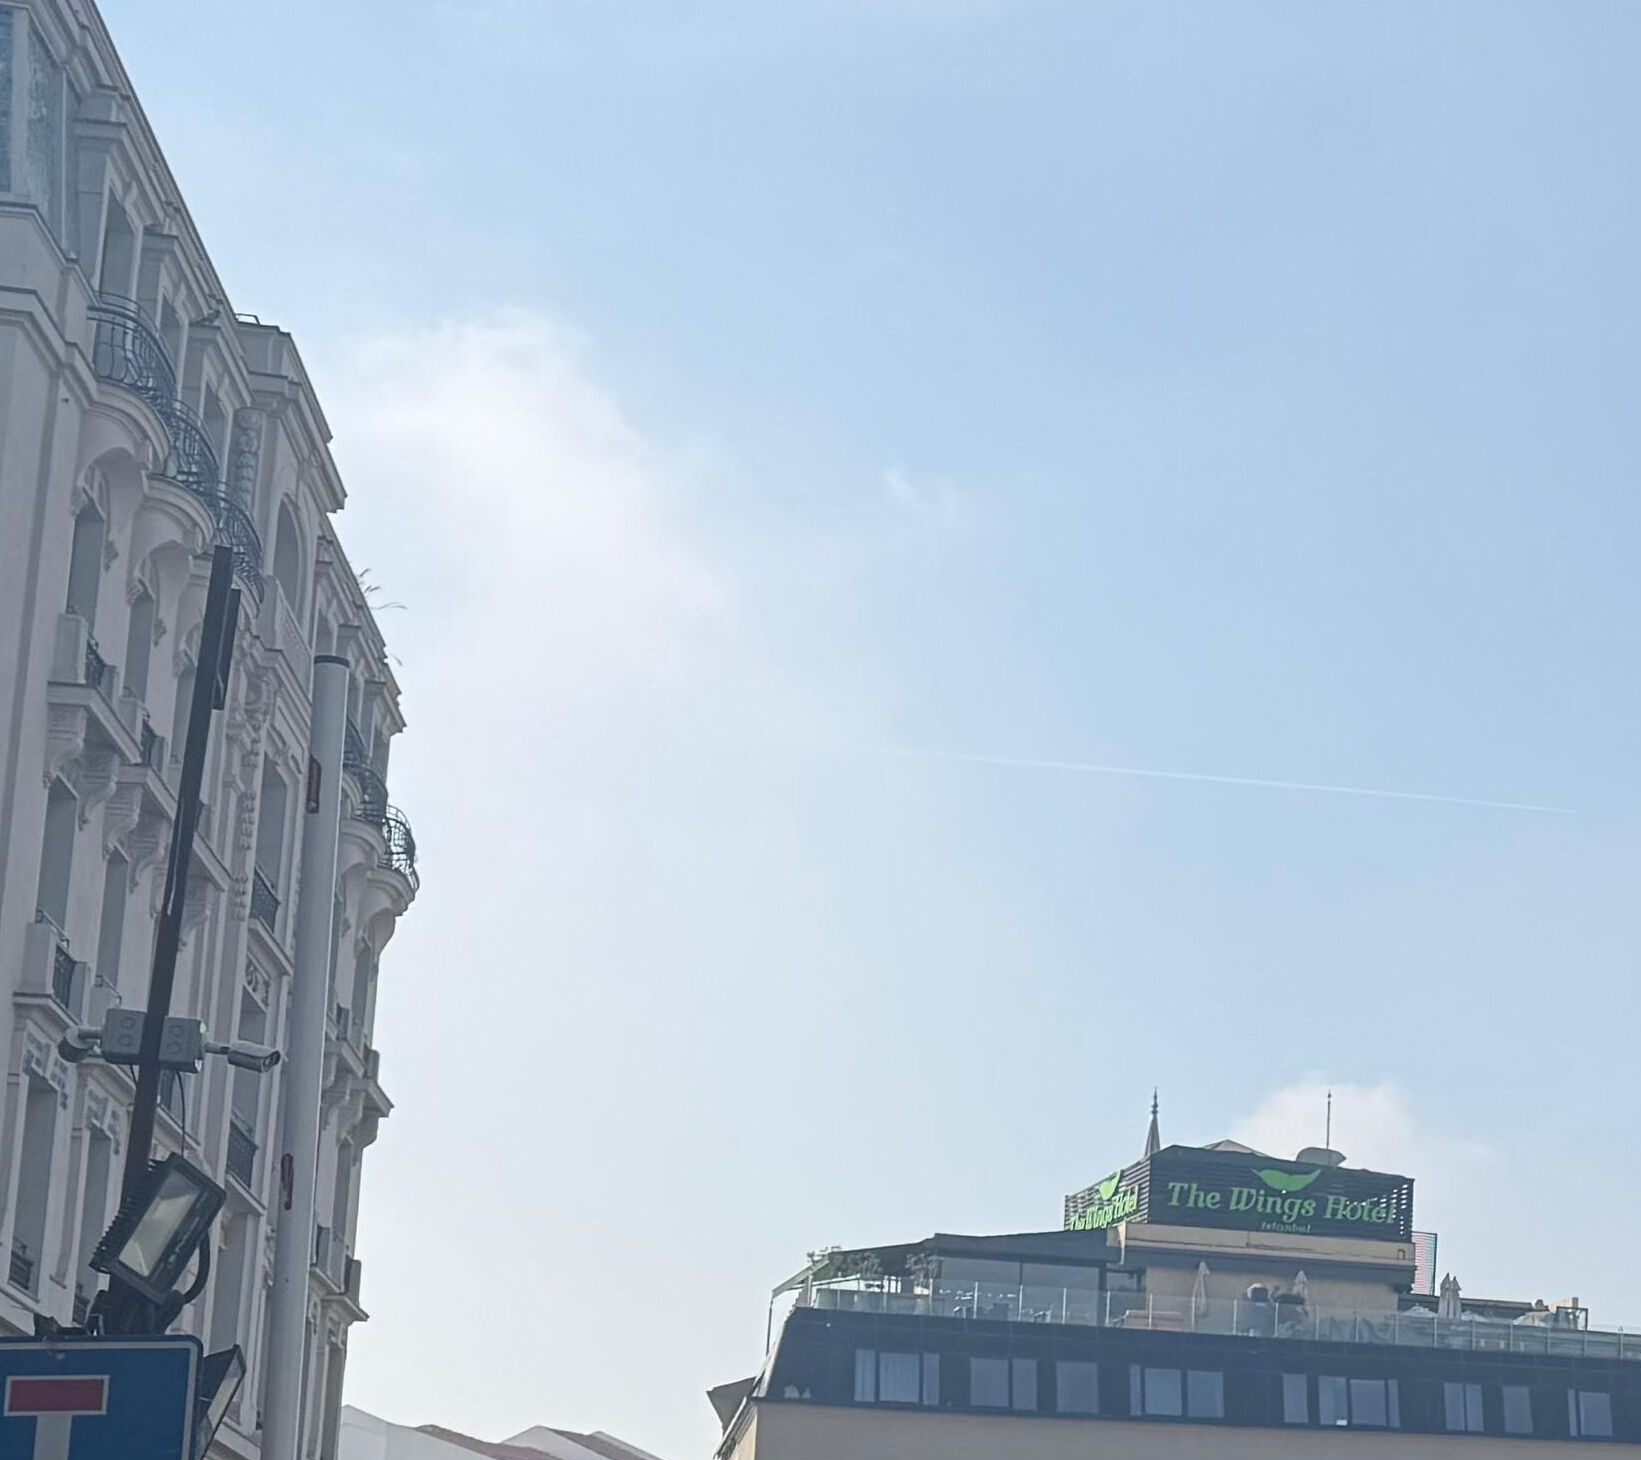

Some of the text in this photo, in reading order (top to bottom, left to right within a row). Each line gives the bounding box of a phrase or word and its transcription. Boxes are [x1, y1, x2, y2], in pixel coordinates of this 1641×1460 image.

[1168, 1182, 1397, 1224] The Wings Hotel
